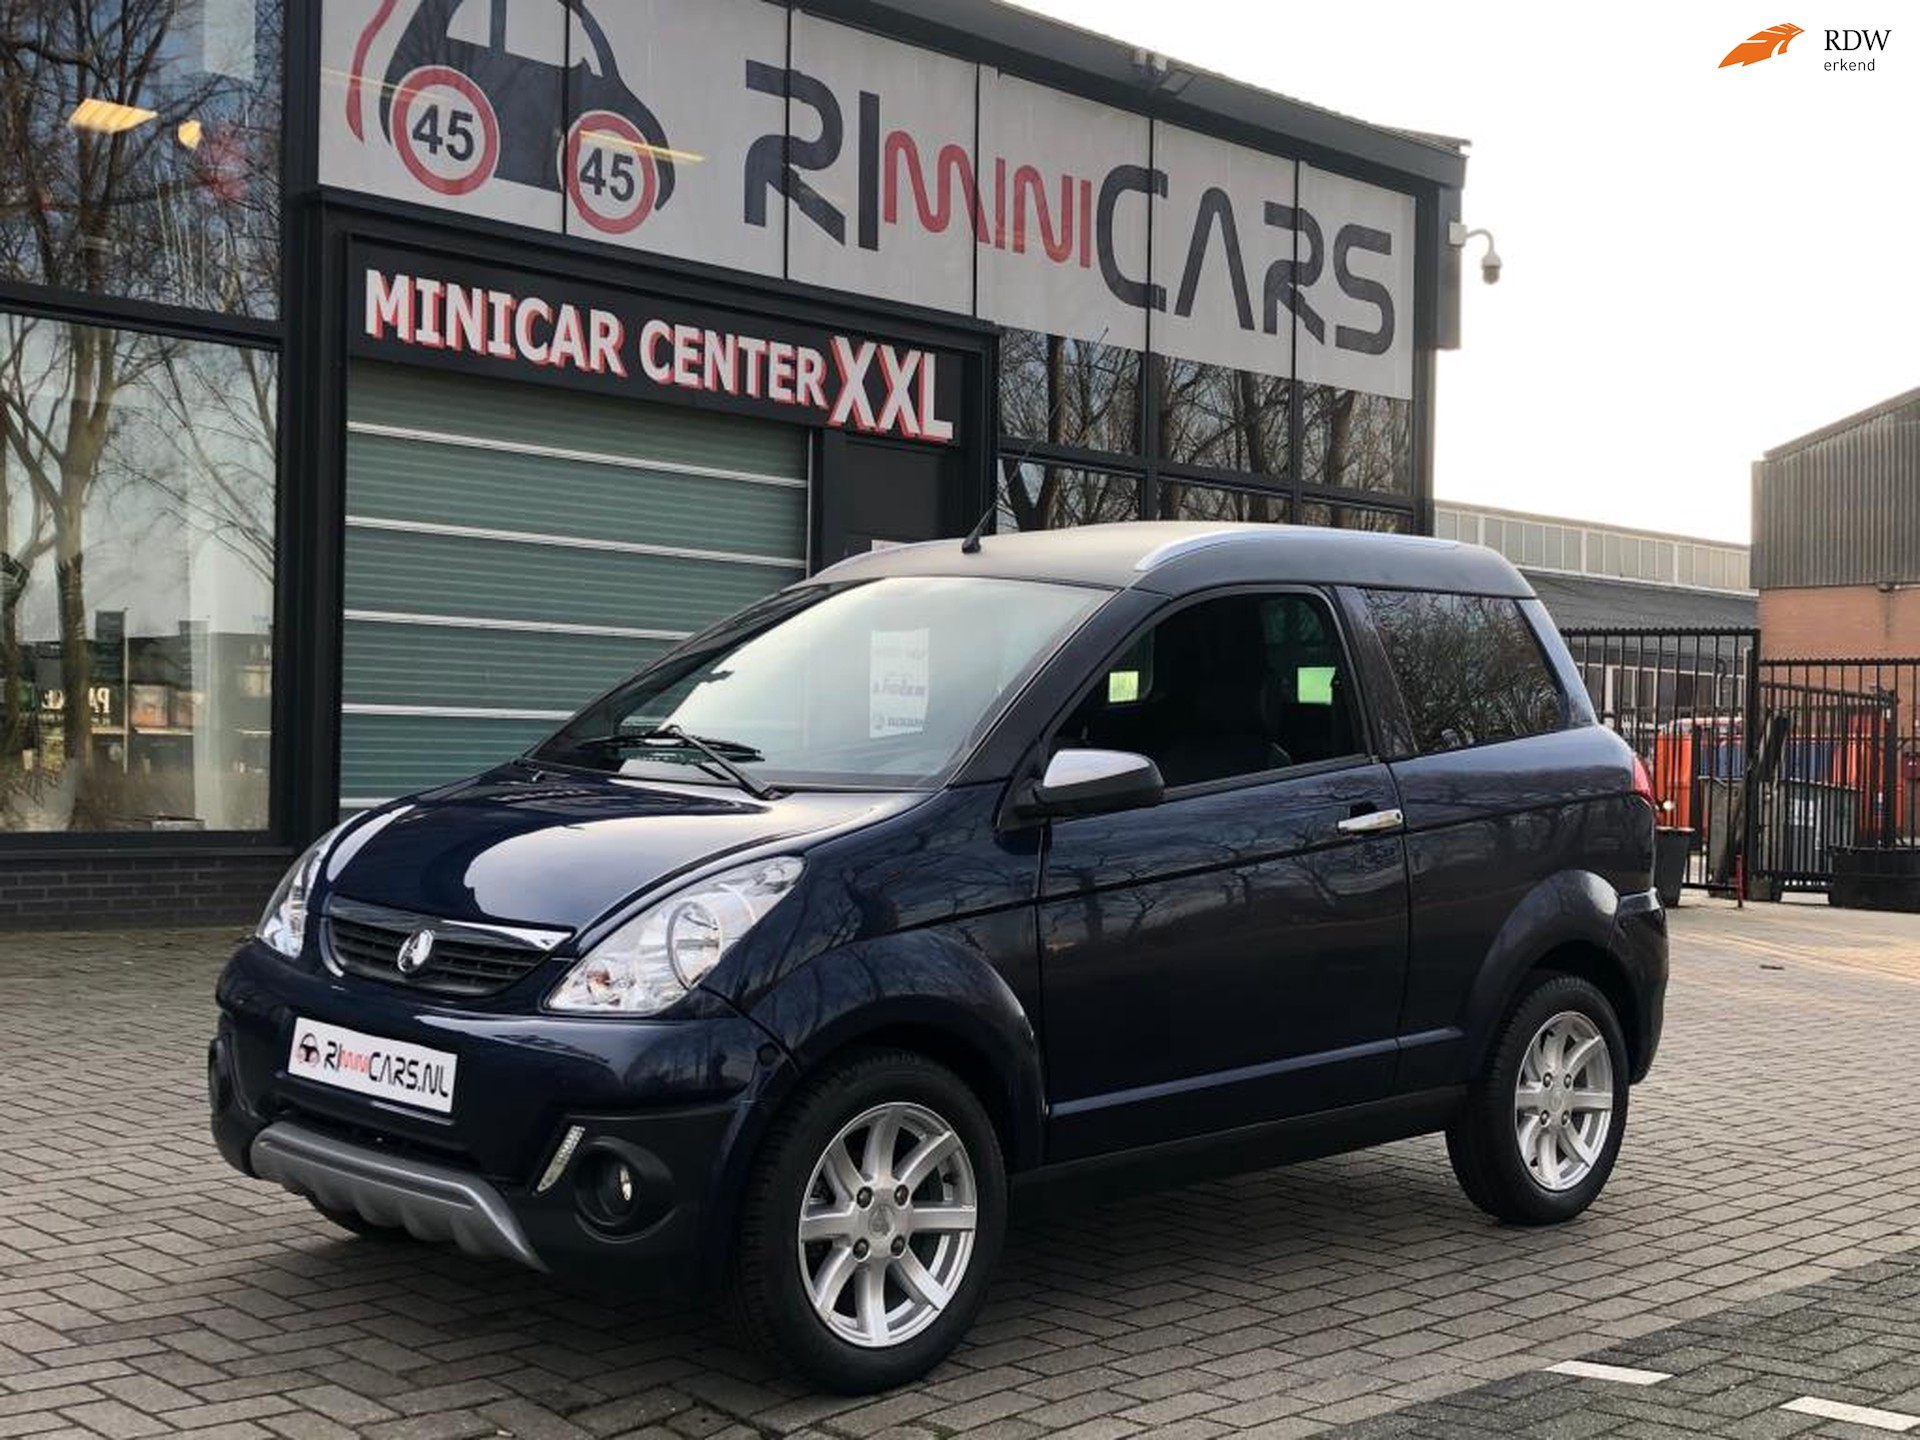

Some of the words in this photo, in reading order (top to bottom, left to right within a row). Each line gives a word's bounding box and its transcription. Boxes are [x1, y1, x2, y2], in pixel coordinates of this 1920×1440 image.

[412, 104, 474, 162] 45
[579, 147, 634, 202] 45
[365, 269, 627, 378] MINICAR
[639, 319, 828, 408] CENTER
[826, 335, 955, 443] XXL
